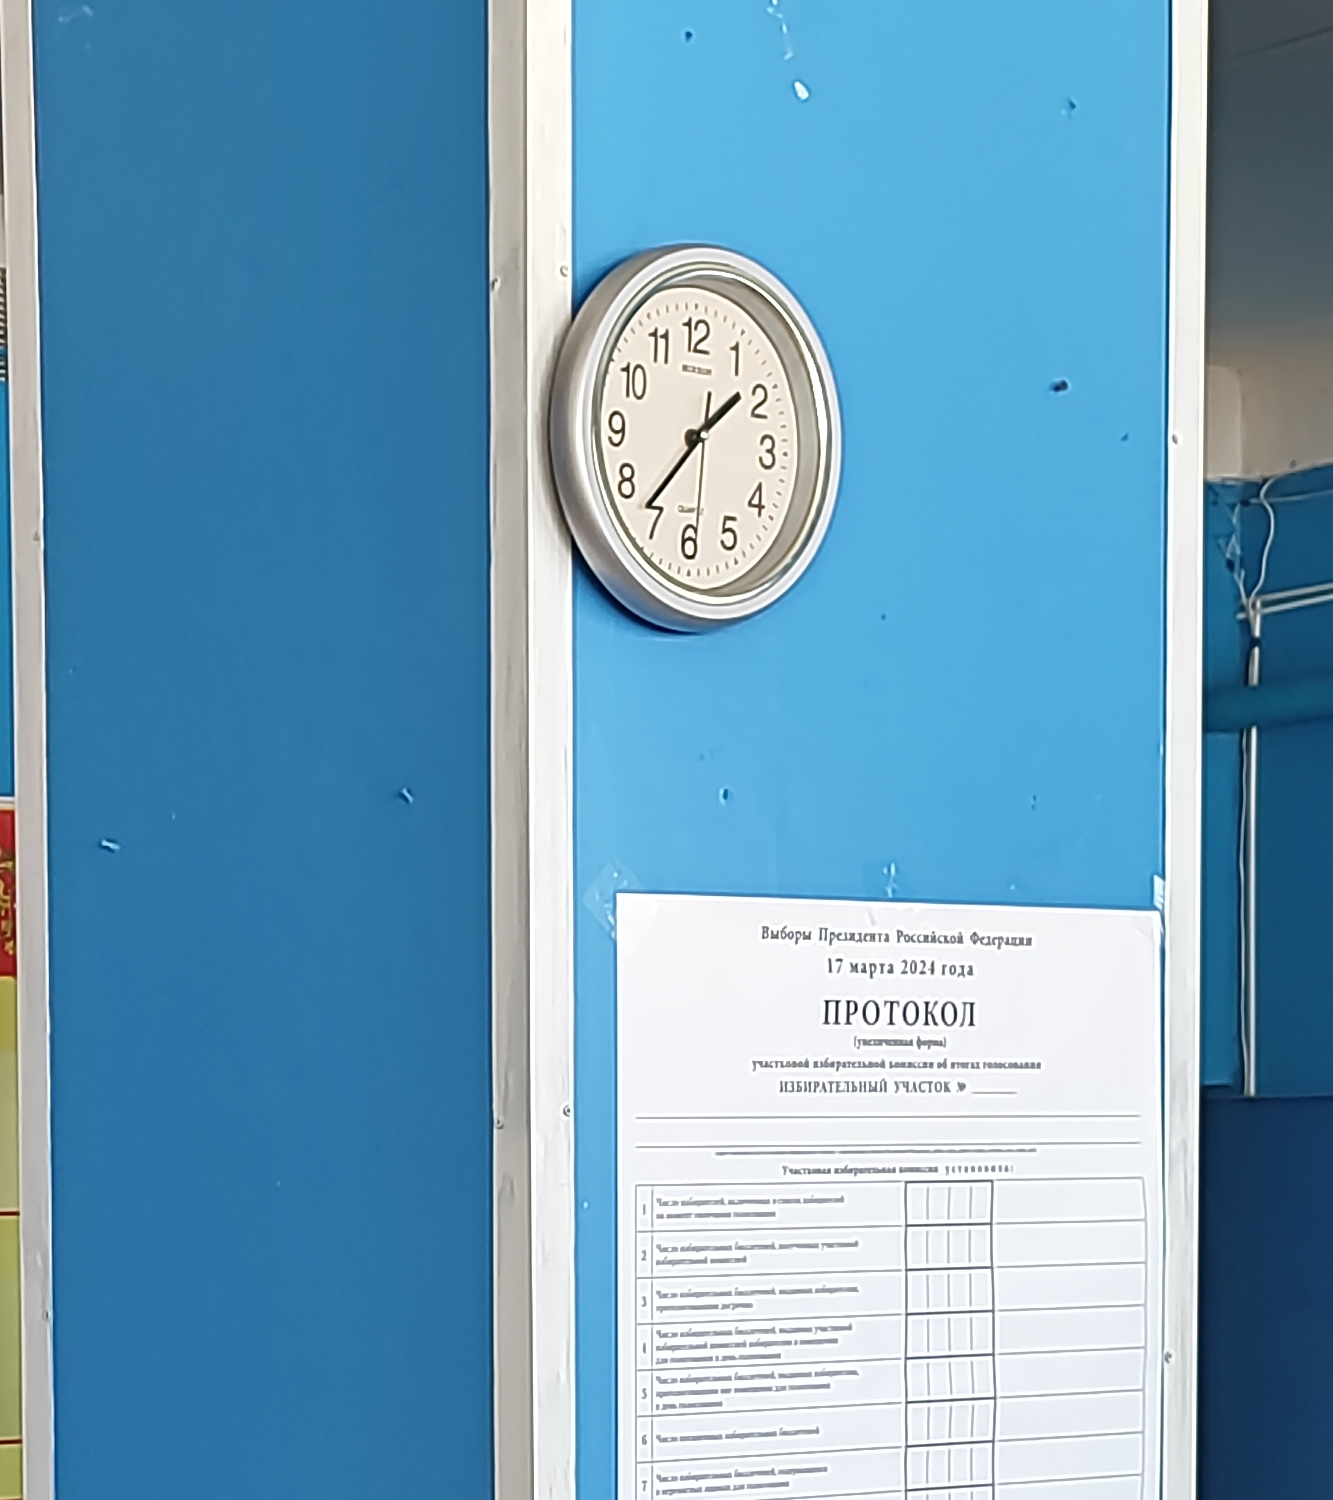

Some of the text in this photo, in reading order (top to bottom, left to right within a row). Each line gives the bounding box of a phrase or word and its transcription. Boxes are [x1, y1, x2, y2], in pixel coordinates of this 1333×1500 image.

[648, 326, 670, 364] 11
[682, 316, 711, 355] 12
[729, 341, 740, 377] 1
[621, 362, 648, 400] 10
[750, 383, 769, 419] 2
[608, 410, 626, 447] 9
[758, 435, 776, 470] 3
[617, 463, 635, 499] 8
[747, 482, 765, 517] 4
[646, 504, 664, 540] 7
[720, 515, 738, 551] 5
[680, 524, 698, 560] 6
[761, 925, 1033, 950] Выборы Президента Российской Федерации
[827, 957, 974, 980] 17 марта 2024 года
[822, 999, 976, 1028] ПРОТОКОЛ
[779, 1078, 888, 1094] ИЗБИРАТЕЛЬНЫЙ
[893, 1080, 952, 1094] УЧАСТОК
